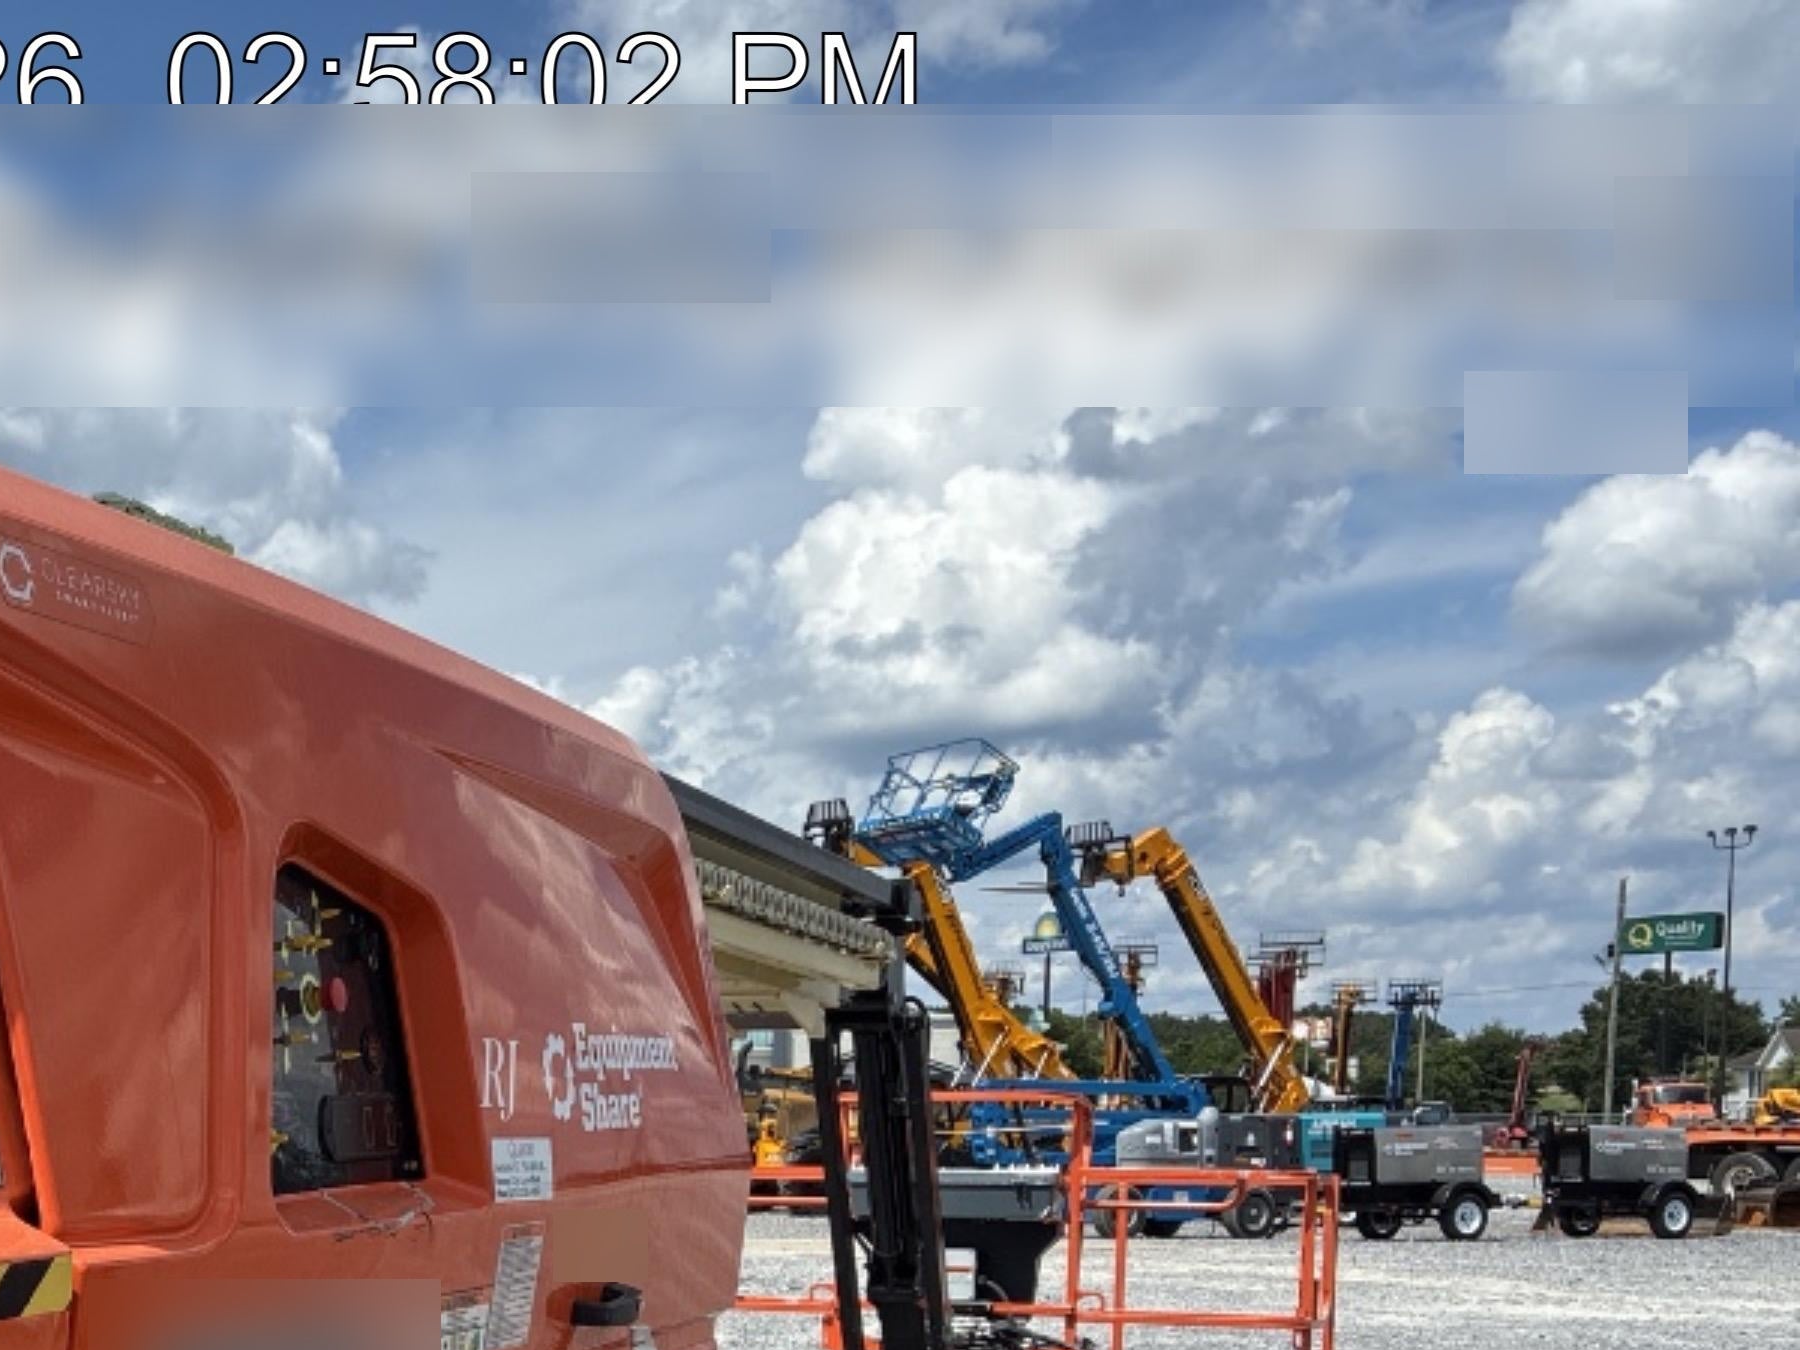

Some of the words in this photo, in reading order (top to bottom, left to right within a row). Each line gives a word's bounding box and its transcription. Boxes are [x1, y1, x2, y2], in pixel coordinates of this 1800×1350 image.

[1655, 919, 1705, 940] Quality
[571, 1022, 679, 1081] Equipment
[479, 1037, 520, 1122] RJ
[579, 1081, 642, 1132] Share
